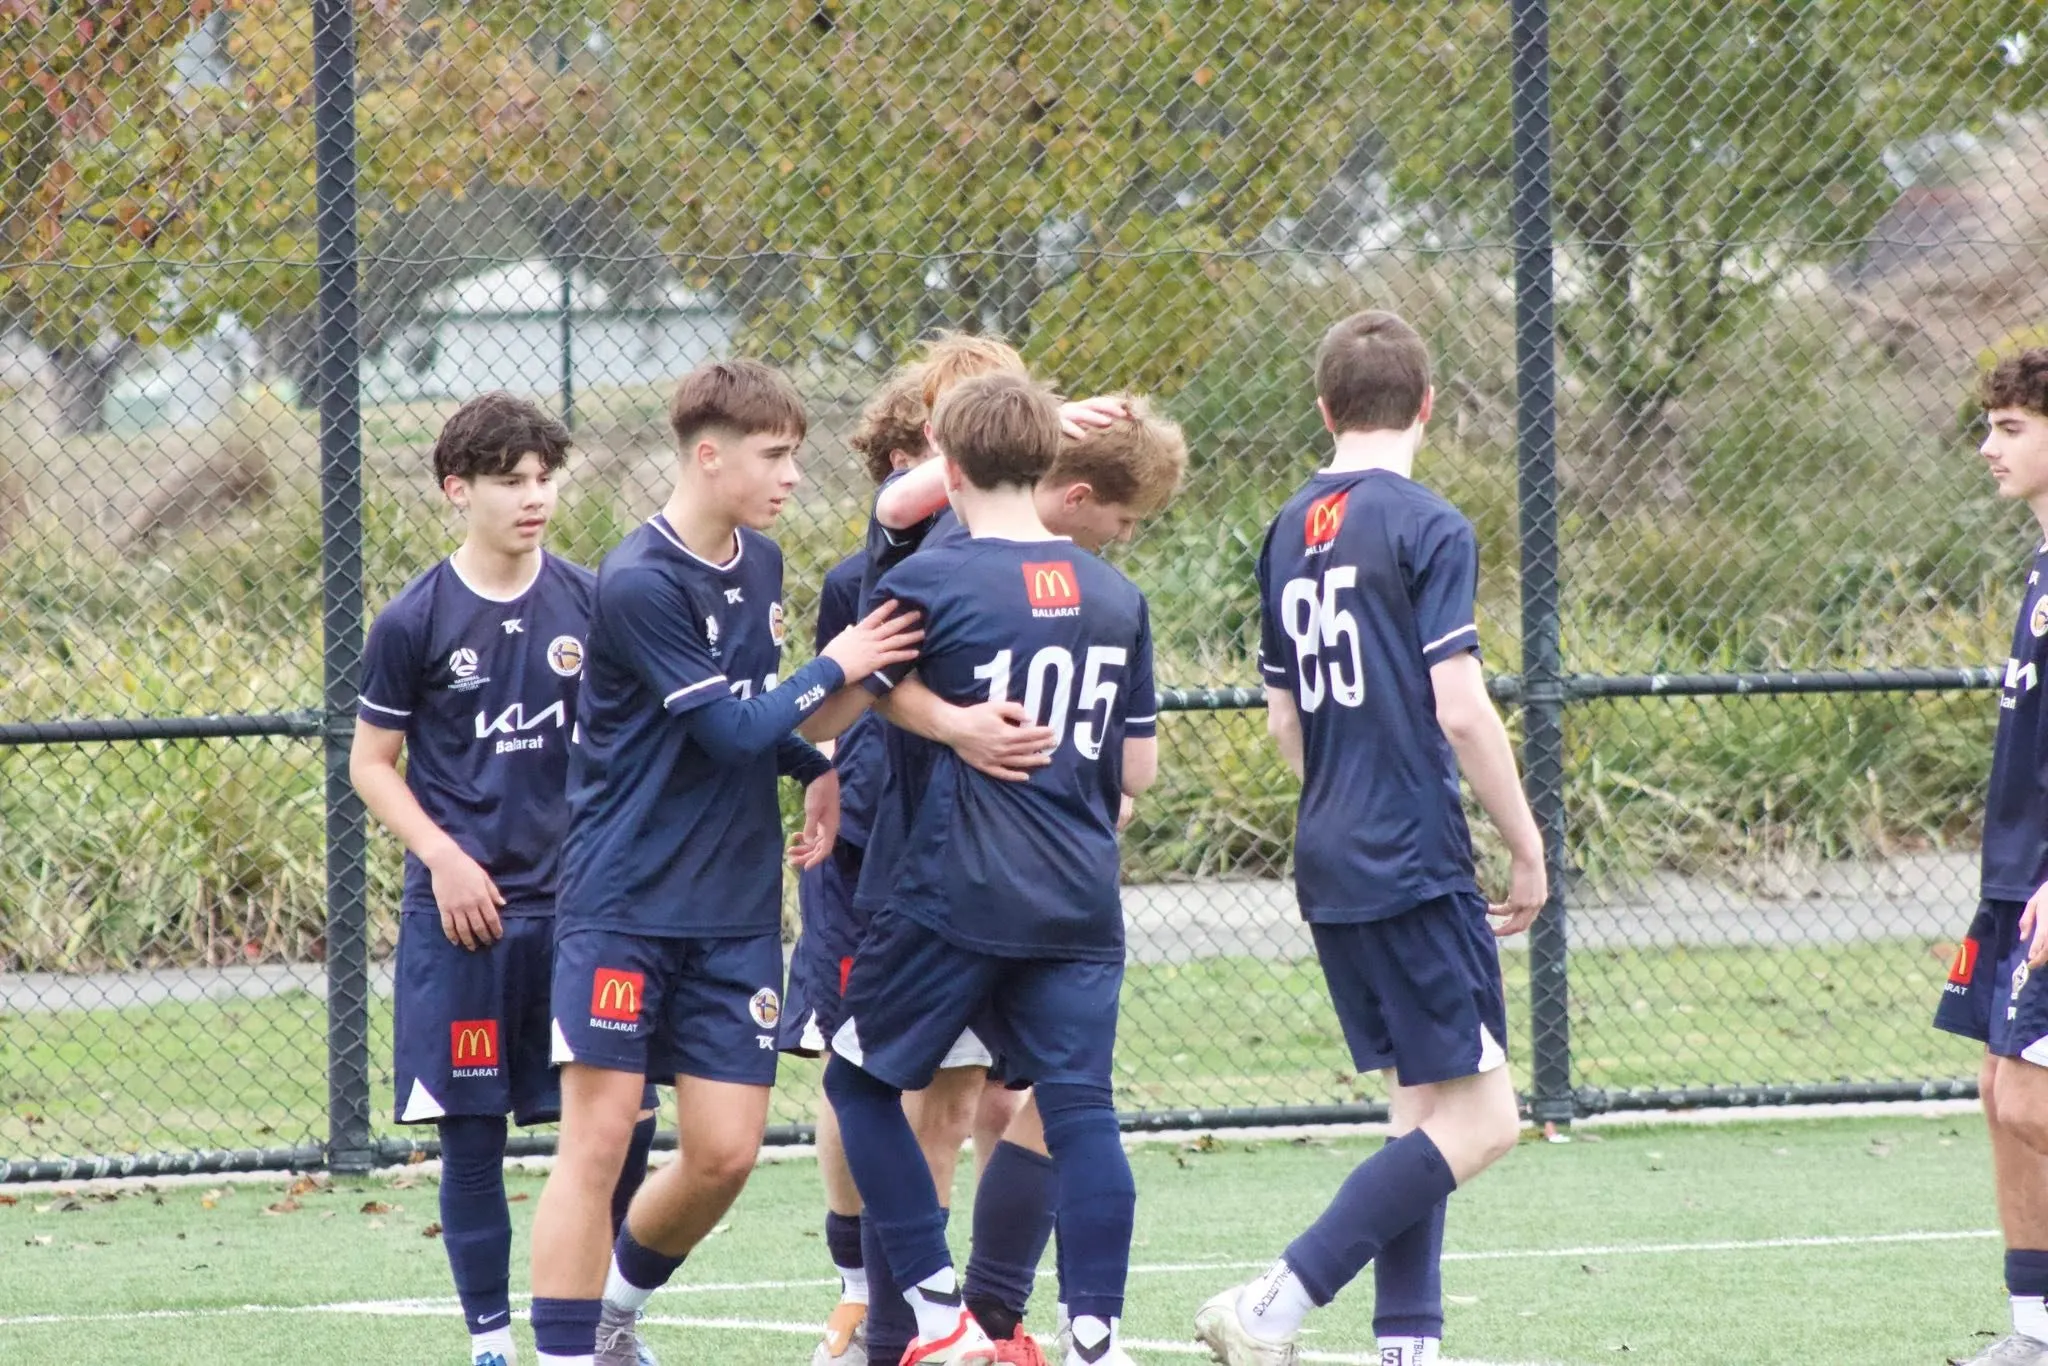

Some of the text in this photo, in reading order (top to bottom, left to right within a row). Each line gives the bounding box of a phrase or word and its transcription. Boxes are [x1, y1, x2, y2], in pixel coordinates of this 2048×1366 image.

[1031, 606, 1081, 618] BALLARAT
[589, 1017, 638, 1033] BALLARAT
[452, 1067, 499, 1078] BALLARAT
